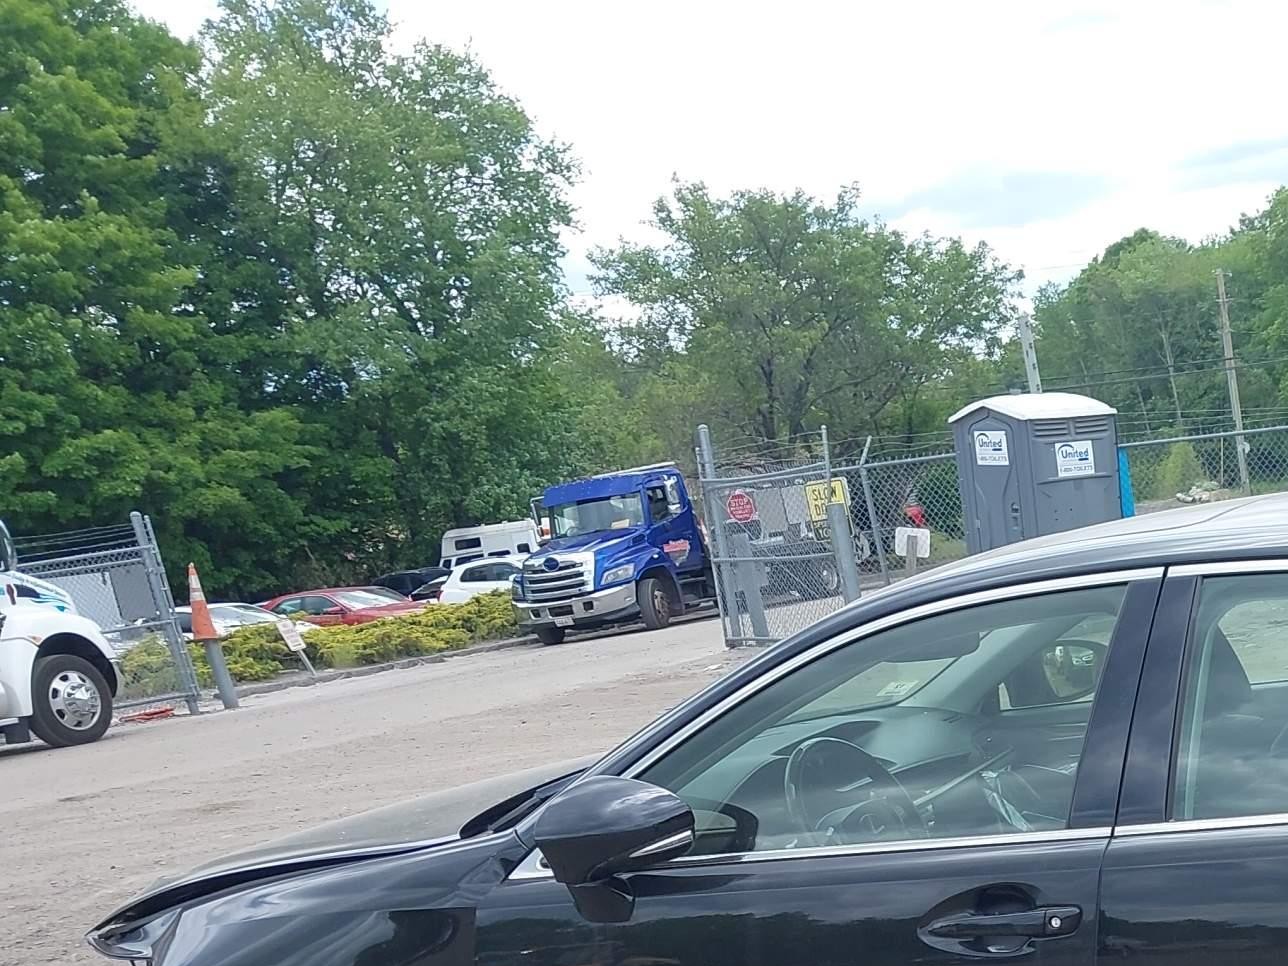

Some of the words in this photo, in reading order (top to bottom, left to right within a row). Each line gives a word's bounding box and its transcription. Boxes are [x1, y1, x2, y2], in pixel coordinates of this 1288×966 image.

[978, 438, 1002, 448] United
[1061, 447, 1089, 459] United
[730, 497, 749, 507] STOP
